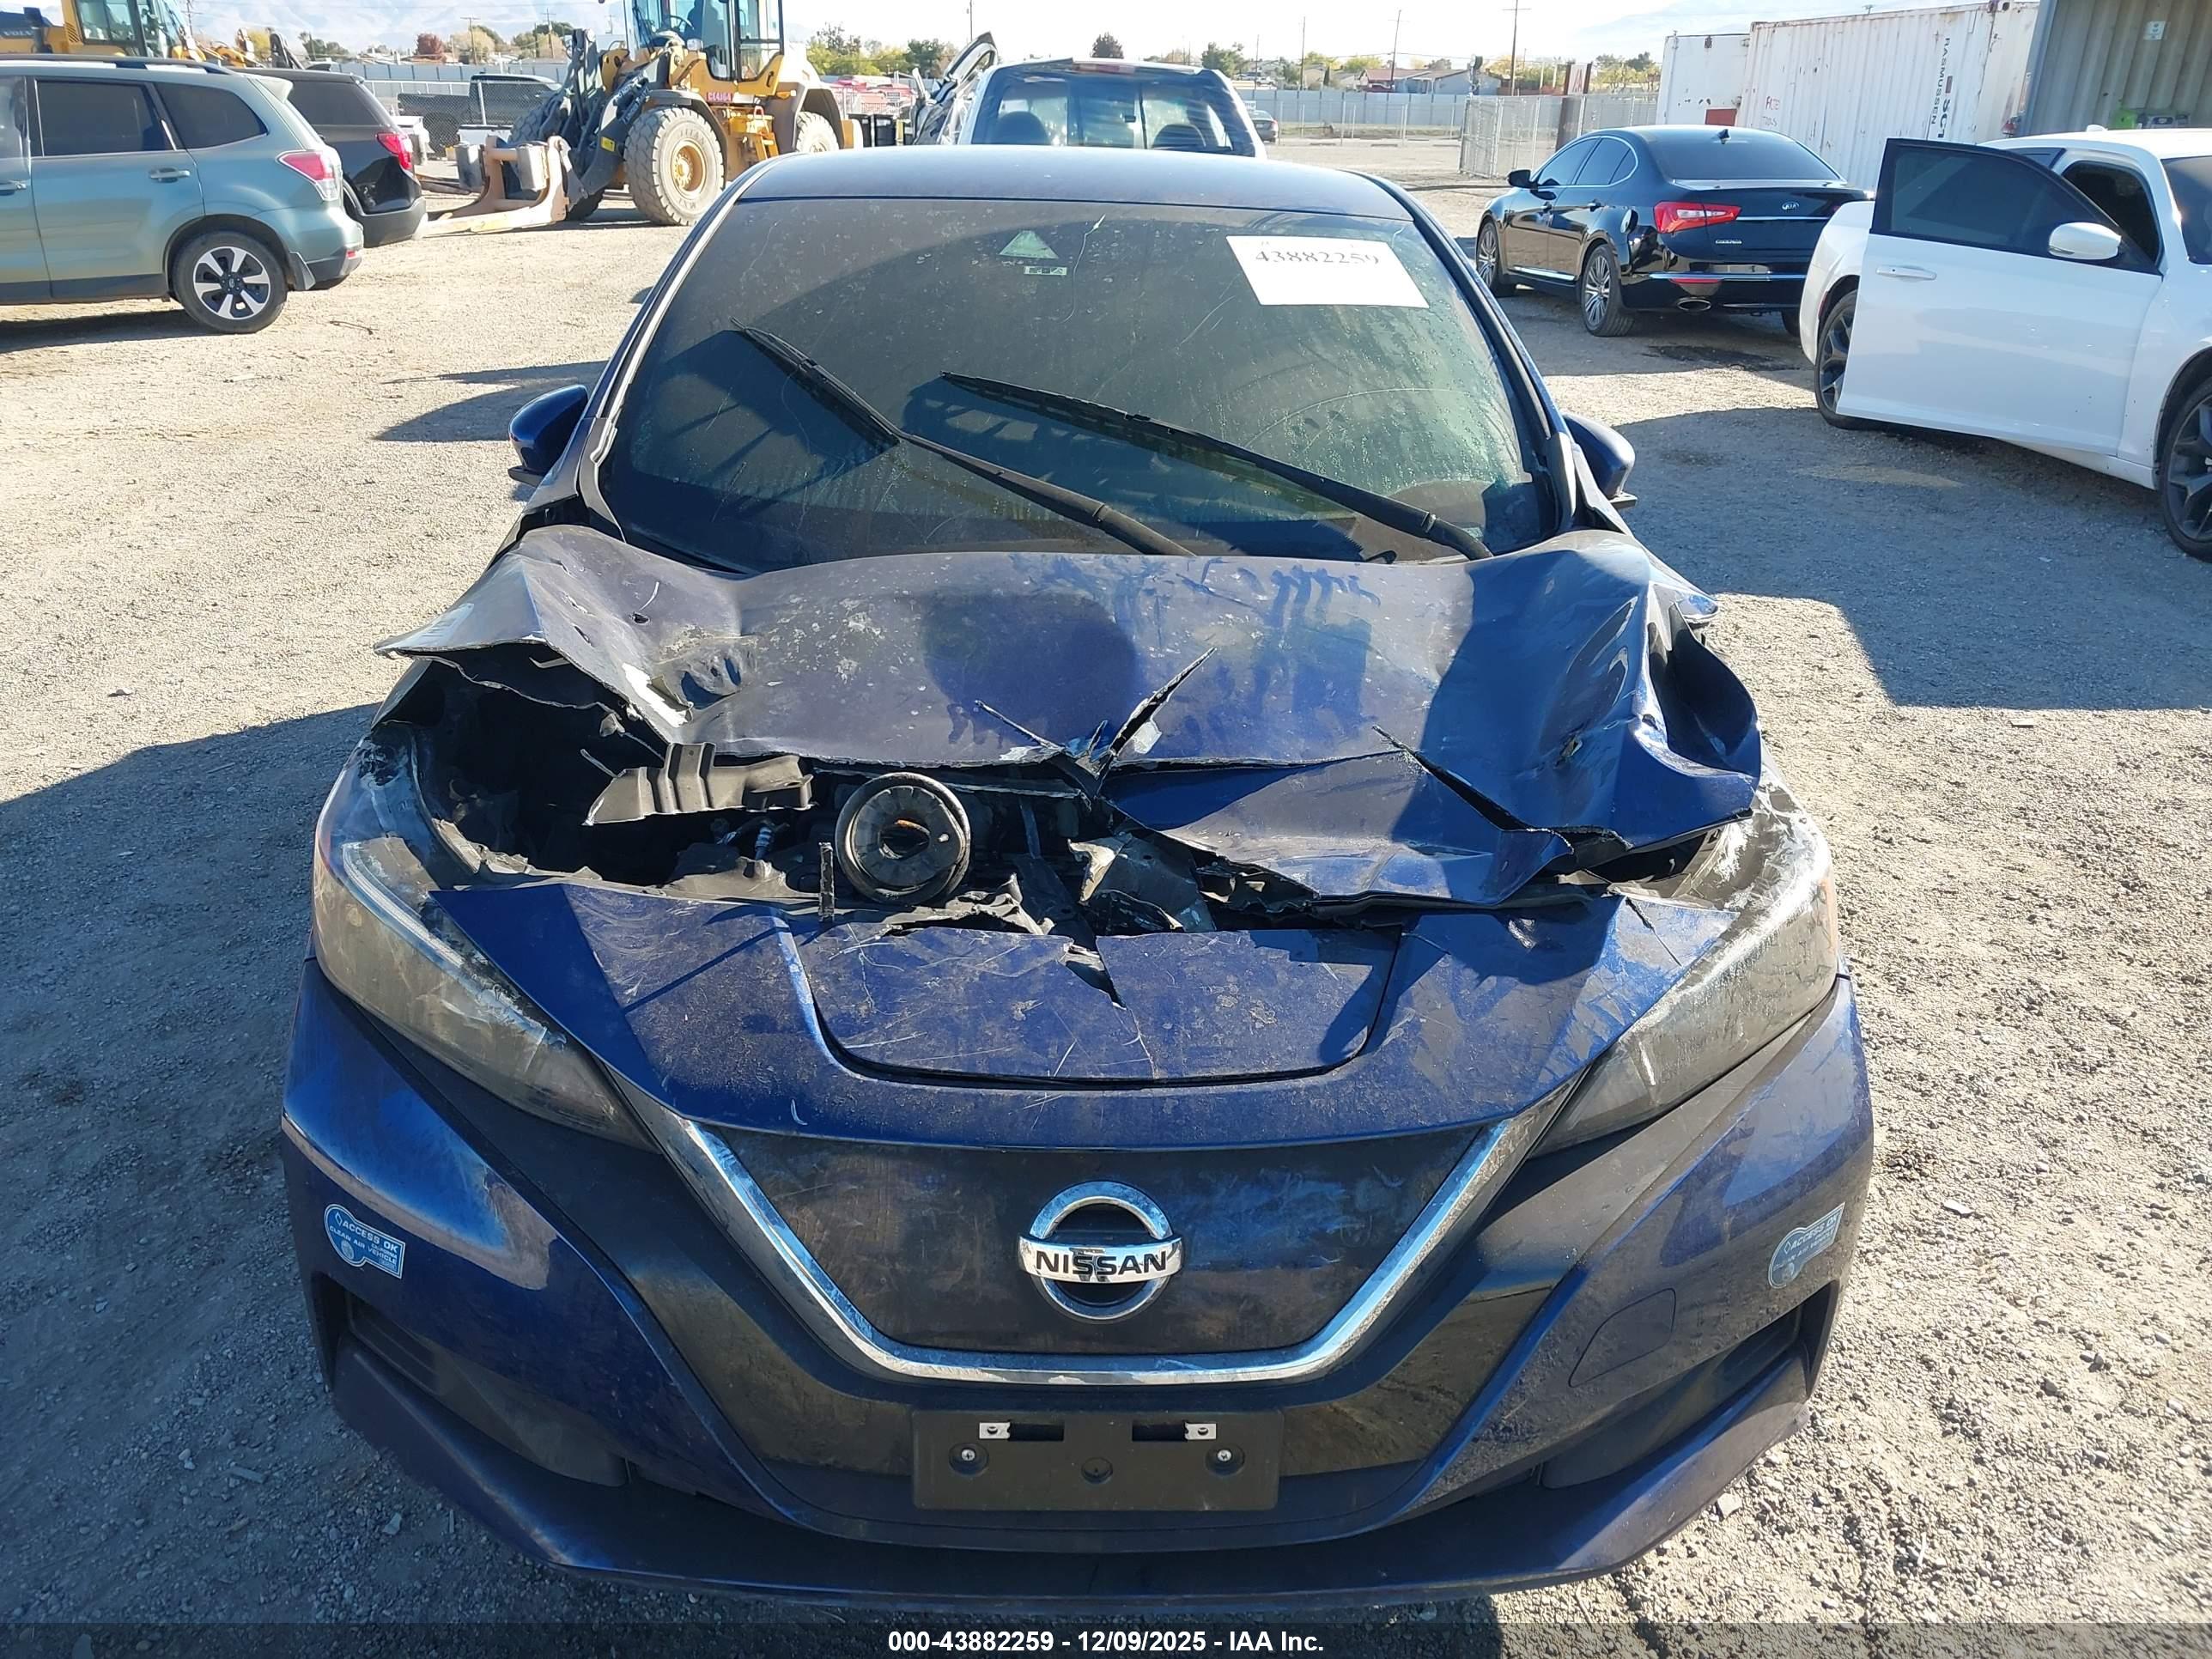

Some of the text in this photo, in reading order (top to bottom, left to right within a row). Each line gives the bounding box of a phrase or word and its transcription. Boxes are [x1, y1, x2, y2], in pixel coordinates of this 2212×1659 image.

[1931, 38, 1950, 124] RASMUSSEN
[330, 1225, 352, 1242] CLEAN
[354, 1239, 365, 1249] AIR
[368, 1245, 398, 1265] VEHICLE
[342, 1220, 398, 1254] ACCESS OK
[1036, 1249, 1167, 1277] NISSAN
